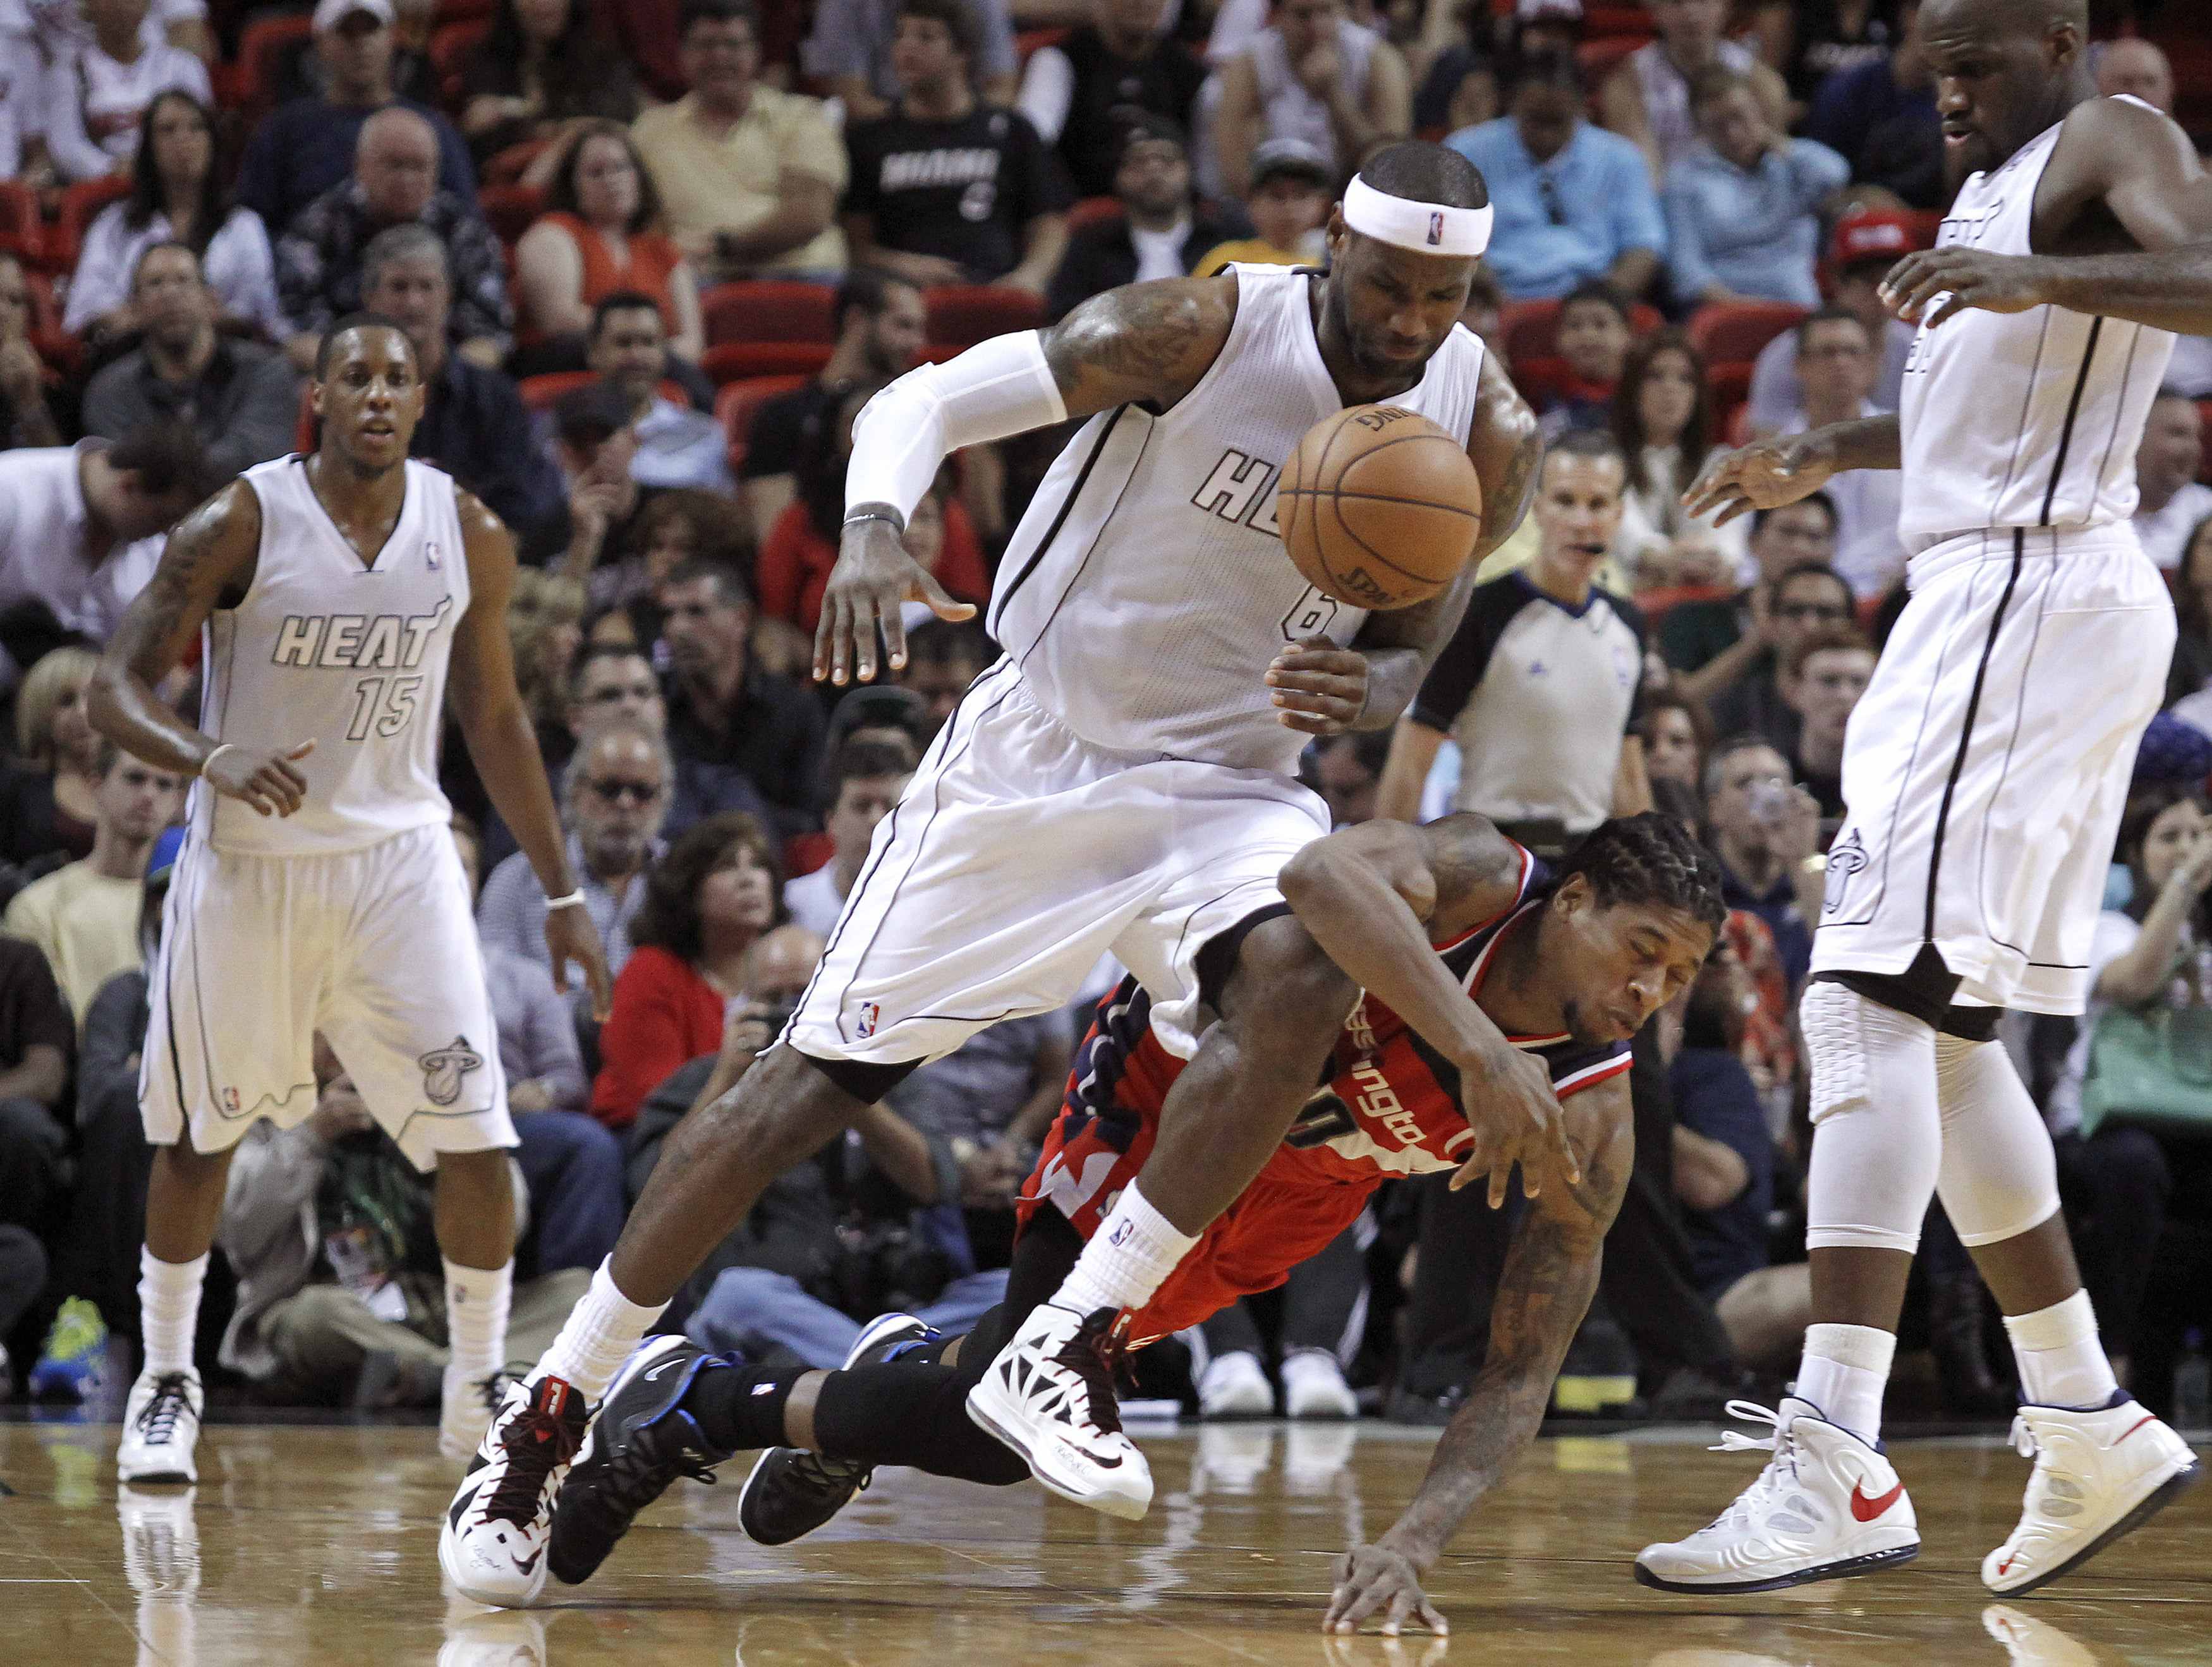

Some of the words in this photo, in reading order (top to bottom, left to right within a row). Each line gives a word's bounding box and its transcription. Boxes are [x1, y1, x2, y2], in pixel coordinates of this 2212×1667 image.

[272, 594, 453, 668] HEAT
[1281, 583, 1339, 642] 6
[347, 673, 423, 740] 15
